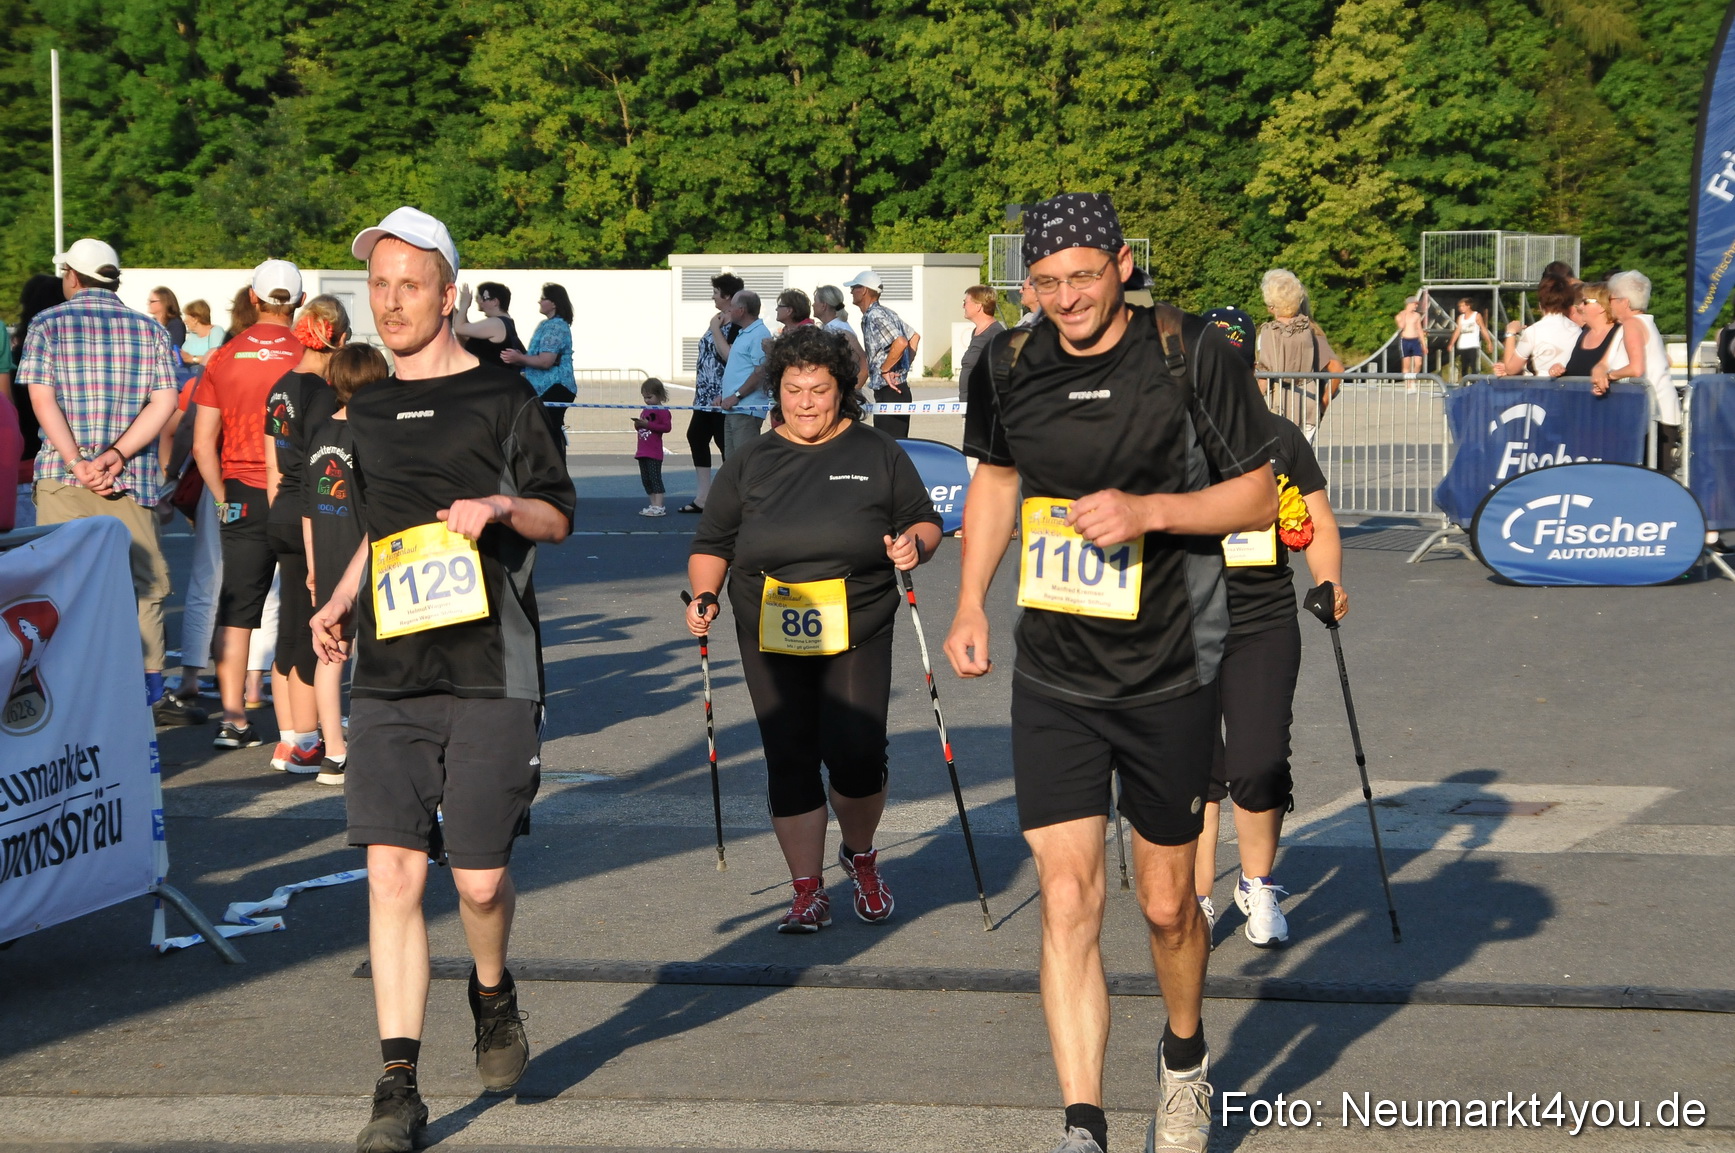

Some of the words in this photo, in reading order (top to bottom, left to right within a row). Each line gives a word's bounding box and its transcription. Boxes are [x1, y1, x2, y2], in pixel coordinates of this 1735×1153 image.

[1533, 516, 1678, 546] Fischer
[1028, 536, 1130, 589] 1101
[1546, 545, 1667, 560] AUTOMOBILE
[377, 555, 477, 612] 1129
[781, 608, 823, 637] 86
[7, 699, 36, 724] 1628
